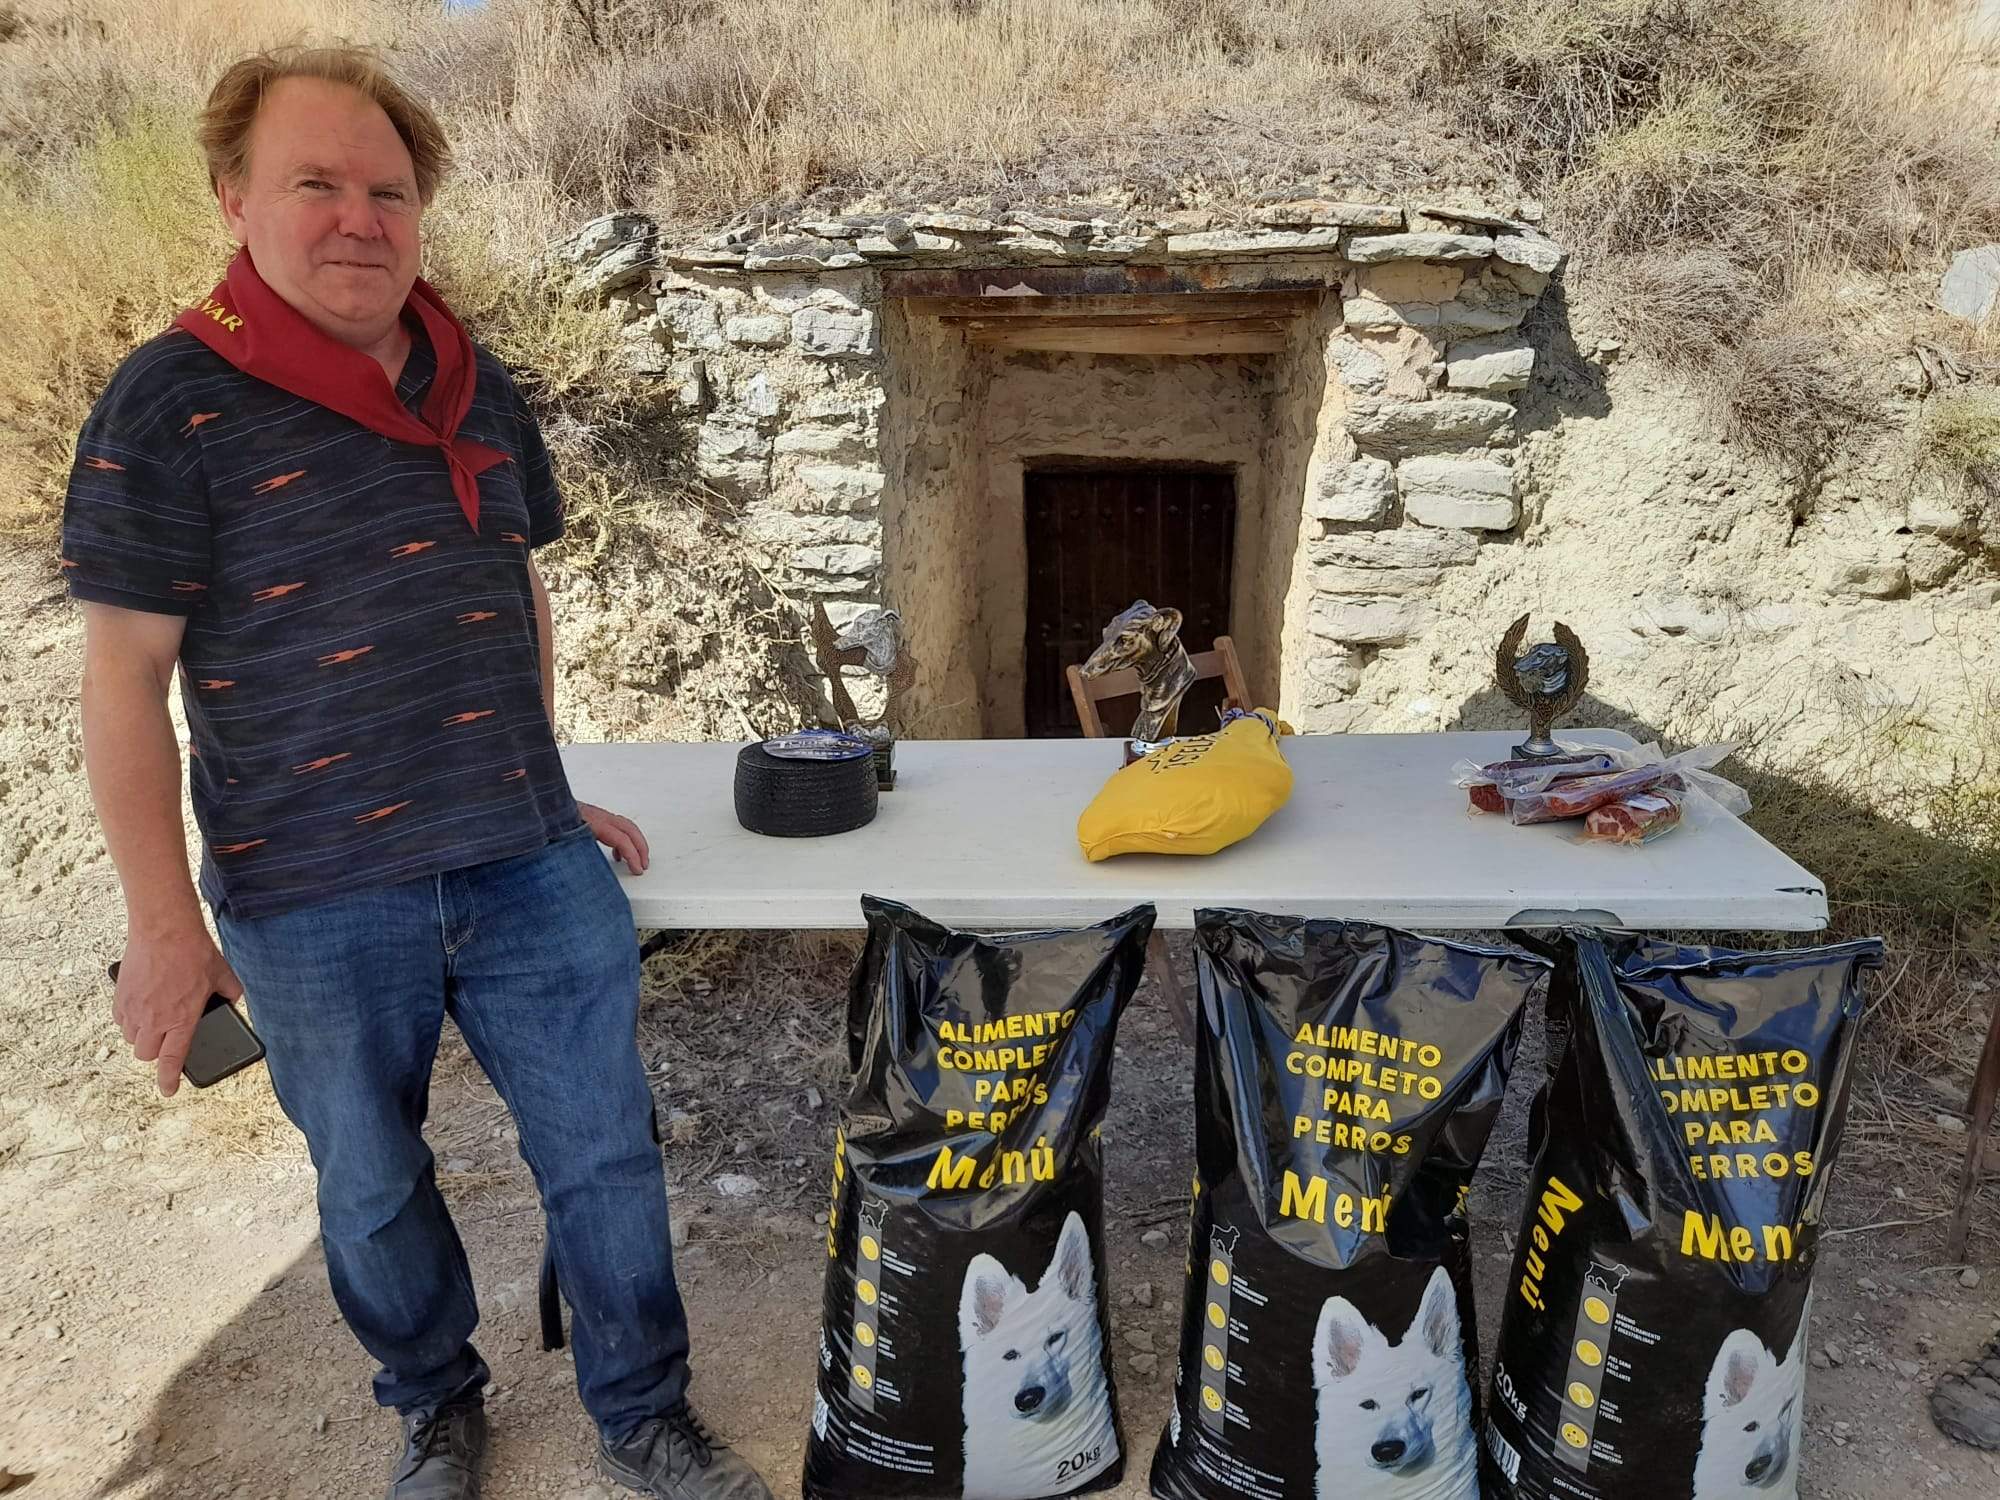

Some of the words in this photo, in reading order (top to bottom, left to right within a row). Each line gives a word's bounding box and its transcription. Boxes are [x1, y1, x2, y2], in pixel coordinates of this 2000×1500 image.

[939, 1008, 1076, 1043] ALIMENTO
[936, 1039, 1059, 1071] COMPLET
[1294, 1022, 1442, 1068] ALIMENTO
[1285, 1051, 1442, 1100] COMPLETO
[1323, 1088, 1392, 1123] PARA
[1660, 1082, 1820, 1115] OMPLETO
[1293, 1115, 1413, 1154] PERROS
[1684, 1119, 1778, 1147] PARA
[1689, 1151, 1815, 1180] ERROS
[1519, 1175, 1584, 1312] Menú
[1680, 1209, 1796, 1263] Men
